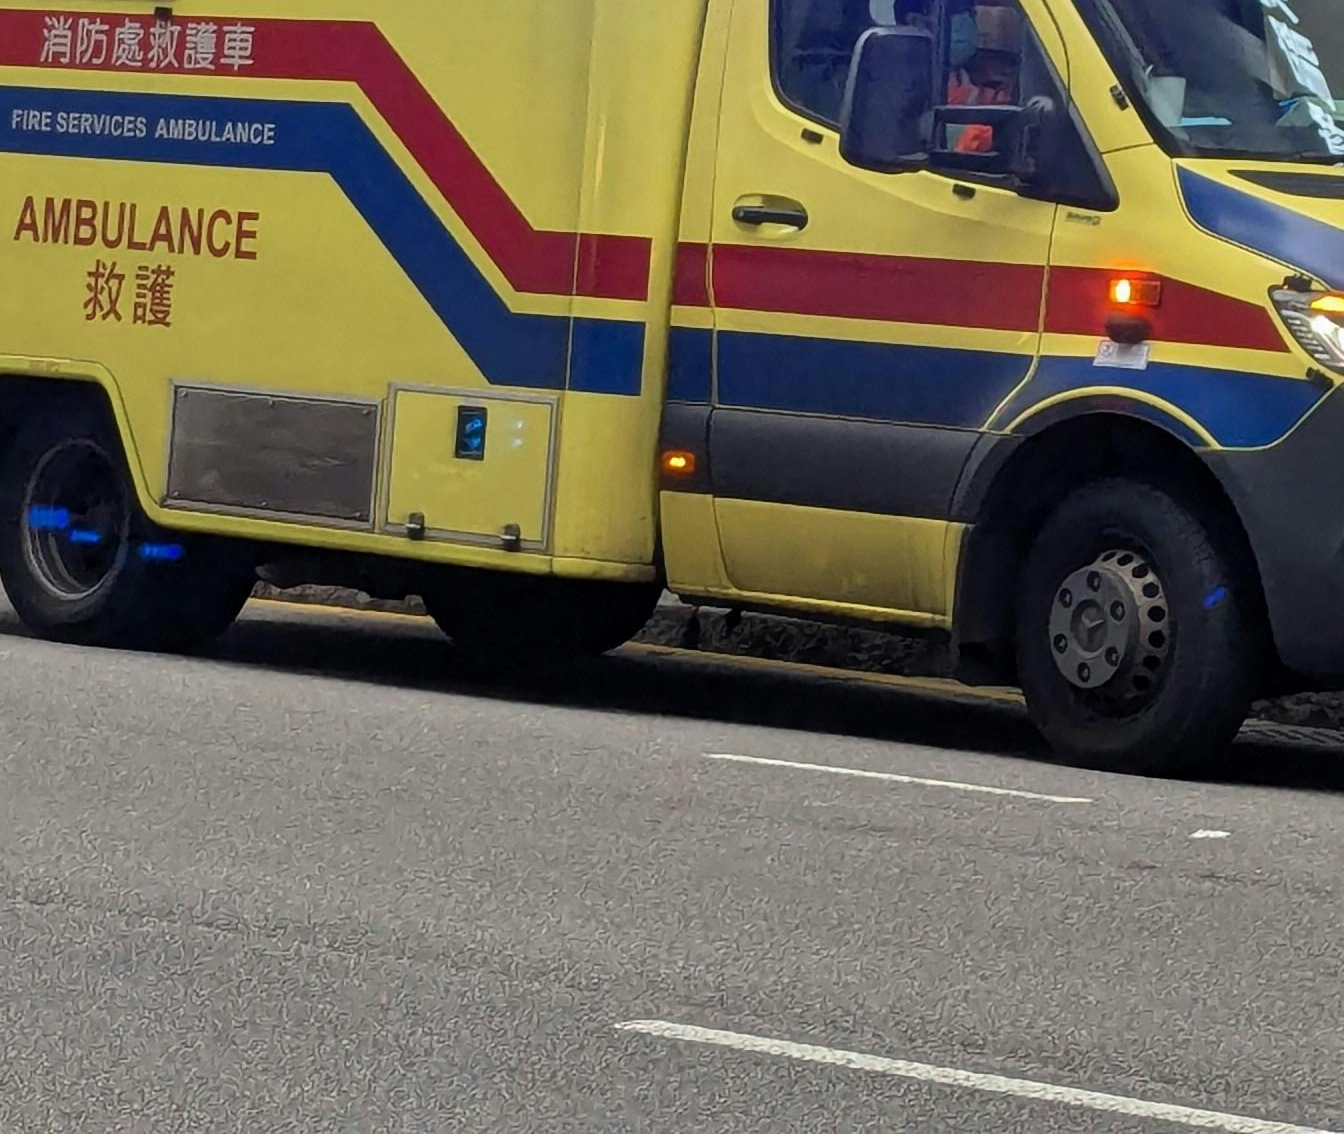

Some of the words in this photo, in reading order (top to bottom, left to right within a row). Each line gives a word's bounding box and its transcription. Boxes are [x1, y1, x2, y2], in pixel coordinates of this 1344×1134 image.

[39, 15, 255, 72] 消防處救護車
[11, 107, 52, 132] FIRE
[56, 111, 147, 138] SERVICES
[154, 117, 276, 146] AMBULANCE
[13, 196, 260, 261] AMBULANCE
[83, 260, 177, 329] 救護
